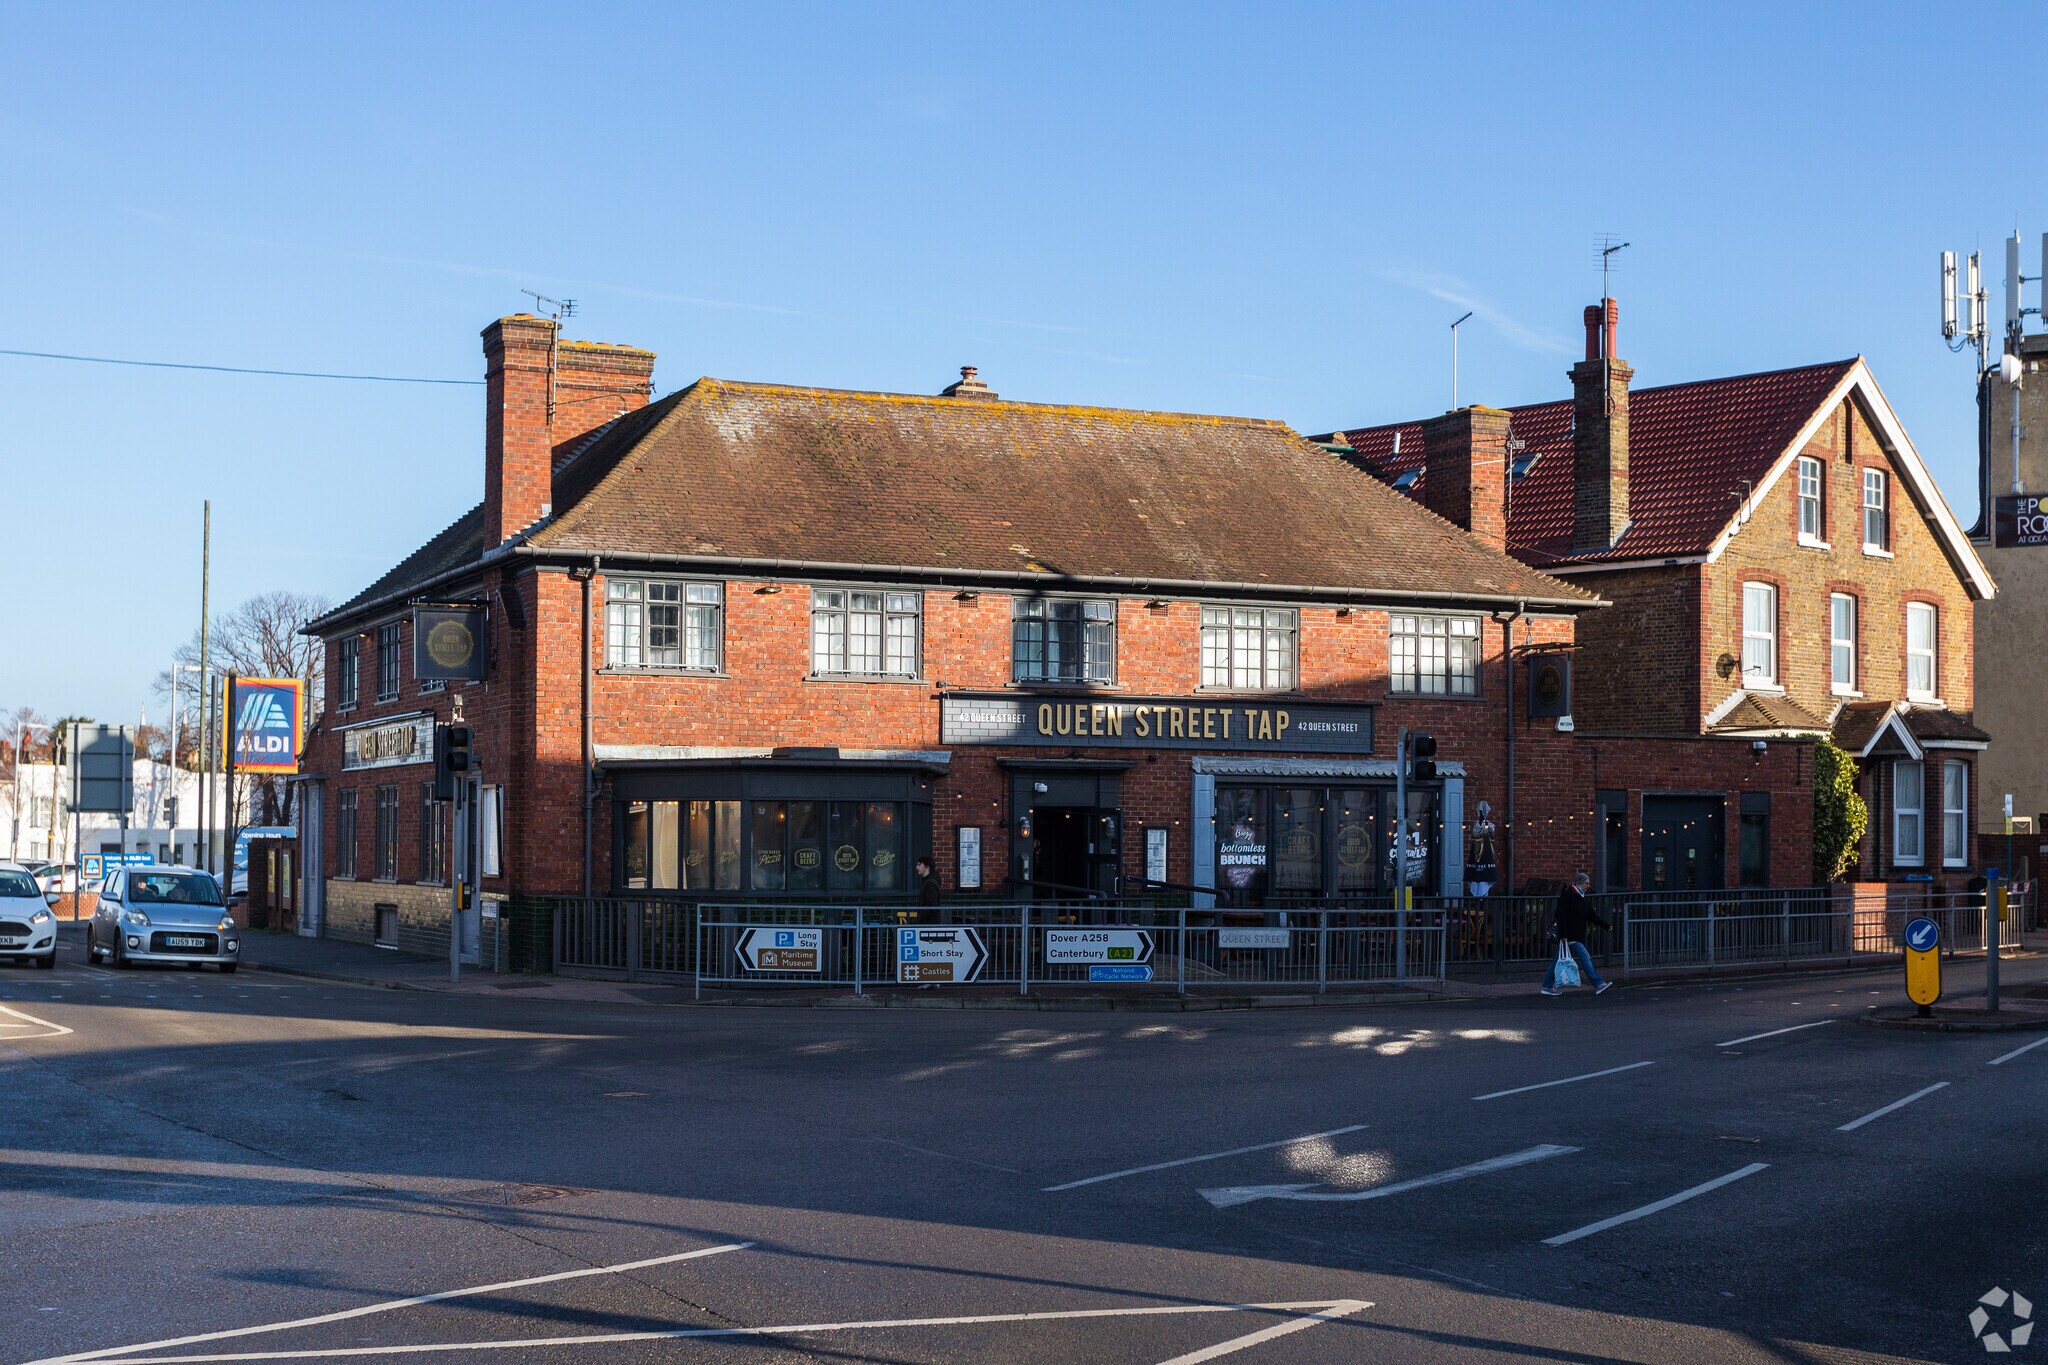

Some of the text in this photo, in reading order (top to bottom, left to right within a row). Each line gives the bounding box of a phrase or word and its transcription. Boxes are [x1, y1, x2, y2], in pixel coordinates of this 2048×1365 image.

[2018, 499, 2026, 514] THE
[959, 713, 1026, 723] 42 QUEEN STREET
[1038, 703, 1290, 740] QUEEN STREET TAP
[1298, 722, 1359, 733] 42 QUEEN STREET
[236, 735, 289, 753] ALDI
[1221, 843, 1266, 853] bottomless
[755, 853, 782, 867] Pizza
[872, 852, 896, 867] Cider
[1220, 855, 1266, 866] BRUNCH
[779, 933, 788, 946] P
[798, 932, 817, 940] Long
[904, 931, 914, 944] P
[1050, 933, 1109, 942] Dover A258
[1221, 934, 1287, 944] QUEEN STREET
[171, 938, 204, 946] AU59 YBK
[800, 940, 818, 949] Stay
[781, 951, 814, 959] Maritime
[904, 948, 914, 960] P
[920, 949, 964, 958] Short Stay
[1050, 948, 1133, 959] Canterbury (A2)
[782, 959, 813, 967] Museum
[922, 967, 950, 975] Castles
